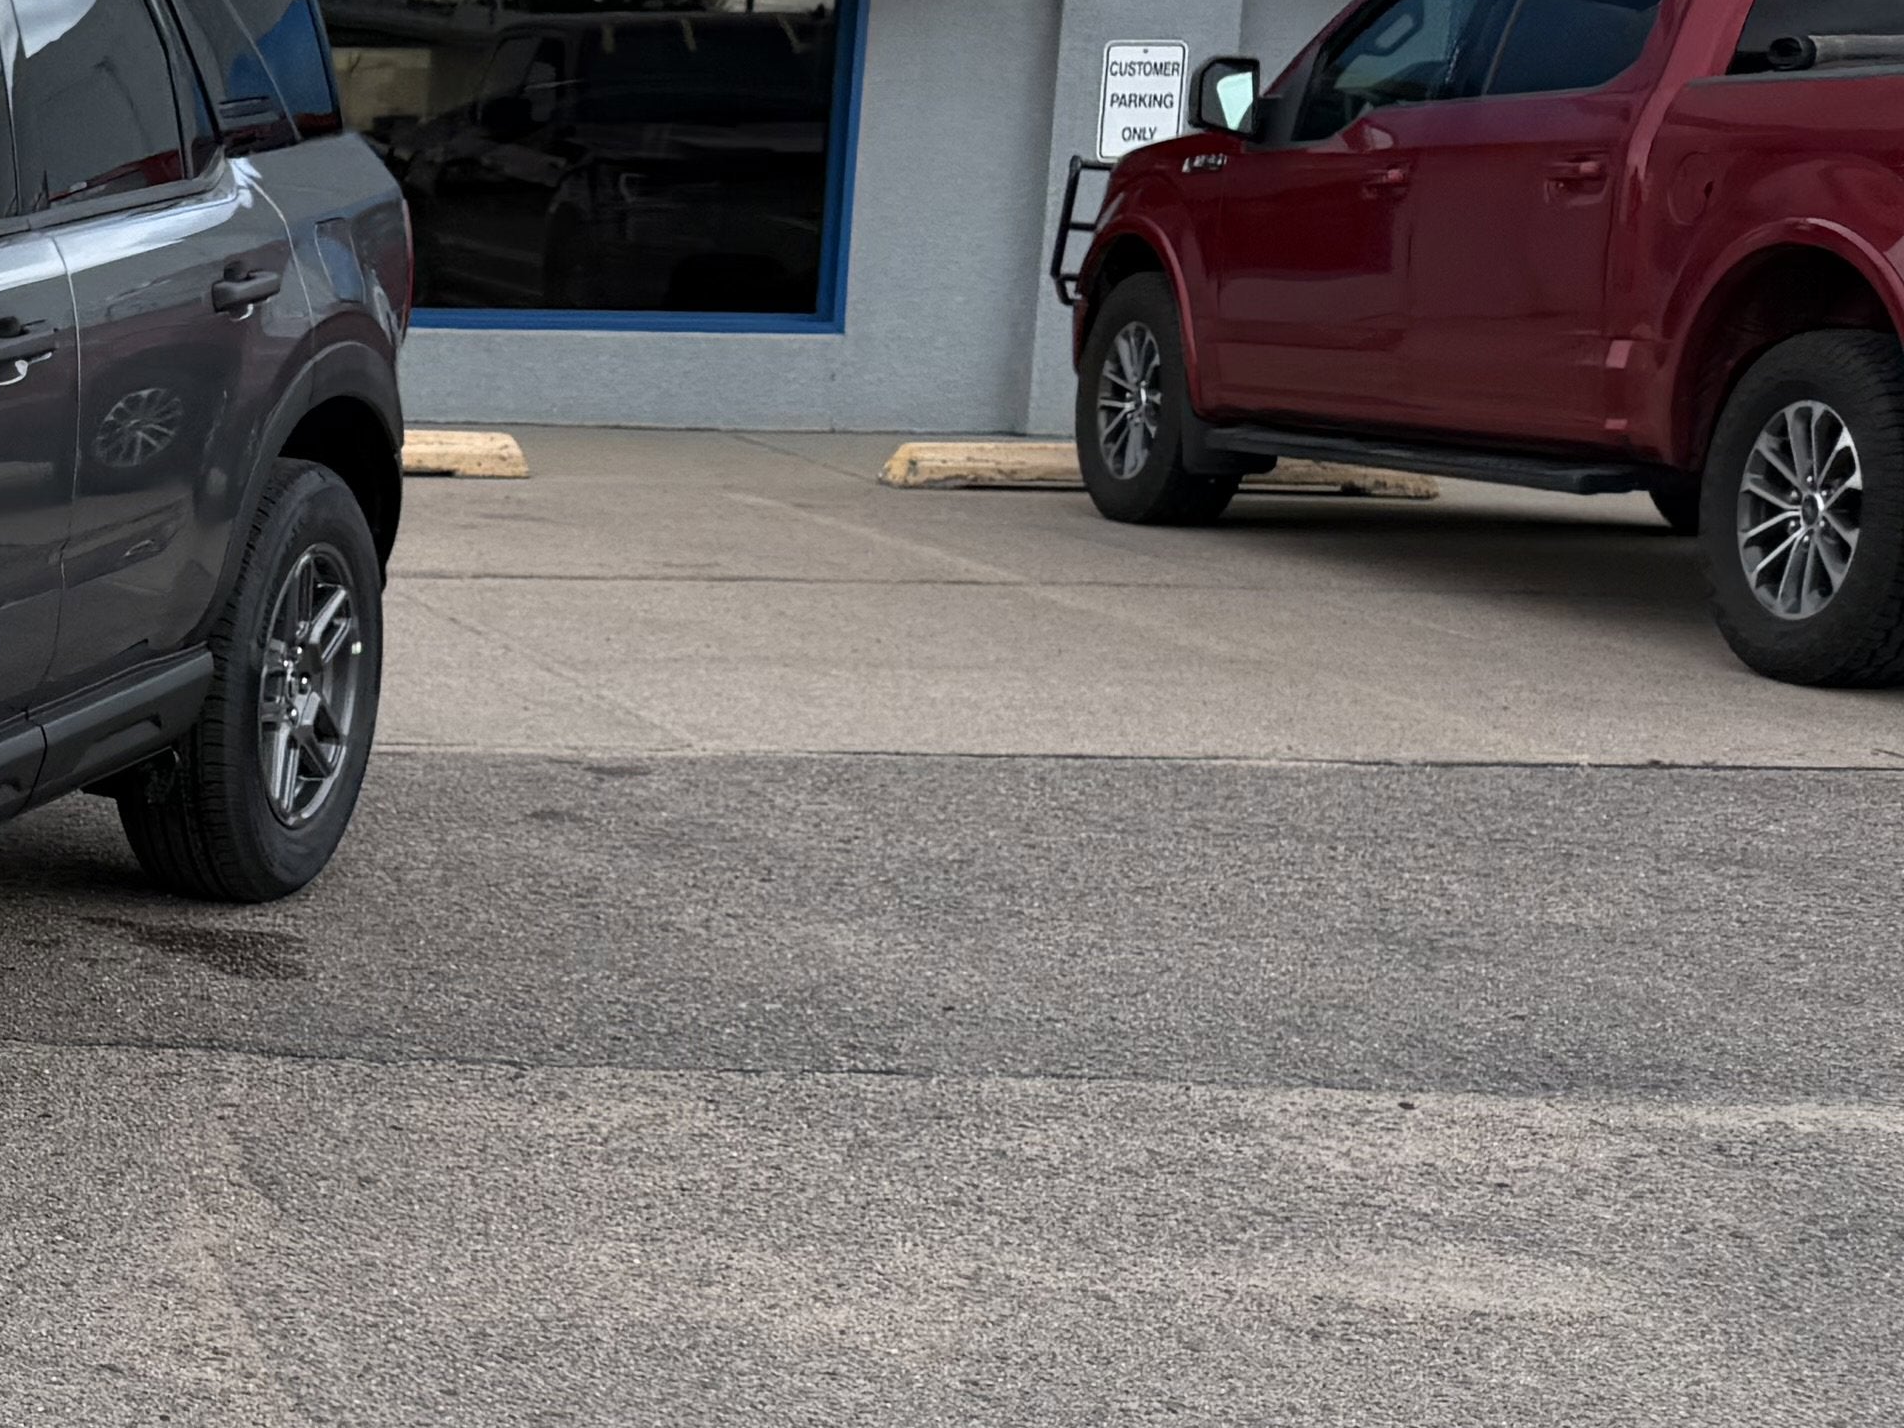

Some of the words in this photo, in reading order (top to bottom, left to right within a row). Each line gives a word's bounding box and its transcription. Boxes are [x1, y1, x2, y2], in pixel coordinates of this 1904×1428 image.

[1109, 60, 1181, 77] CUSTOMER
[1109, 93, 1174, 109] PARKING
[1121, 126, 1158, 142] ONLY
